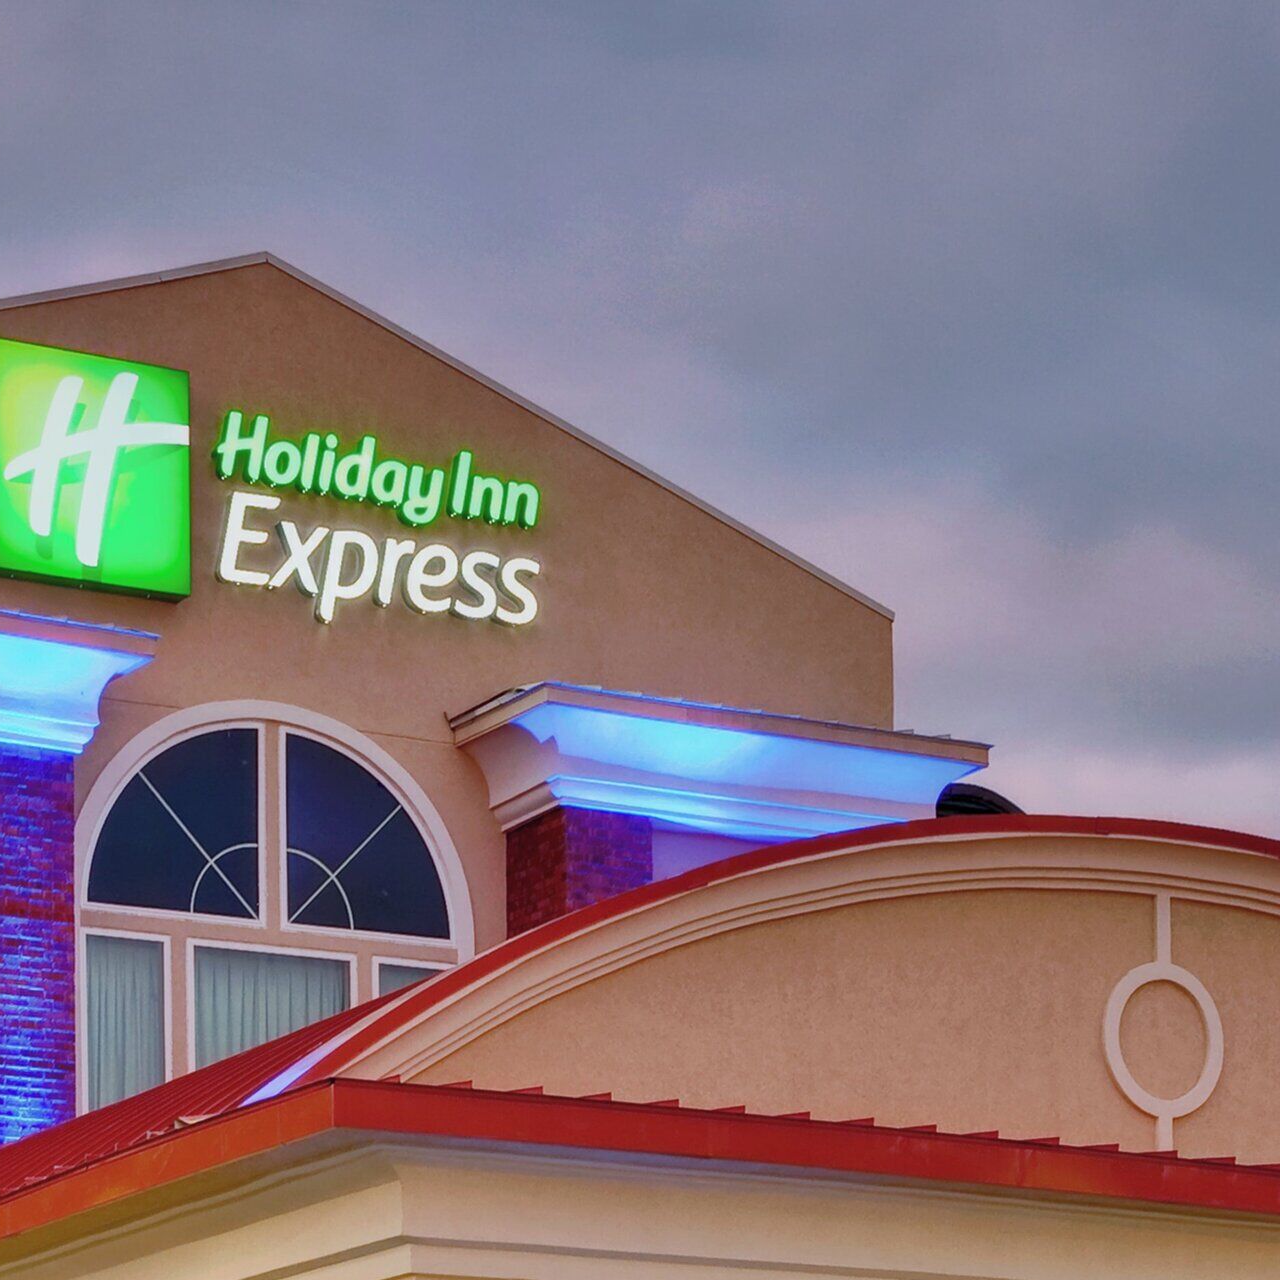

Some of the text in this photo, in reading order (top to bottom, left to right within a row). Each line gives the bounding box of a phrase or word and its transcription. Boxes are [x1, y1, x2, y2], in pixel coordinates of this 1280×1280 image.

[215, 410, 540, 528] Holiday Inn
[218, 491, 541, 626] Express
